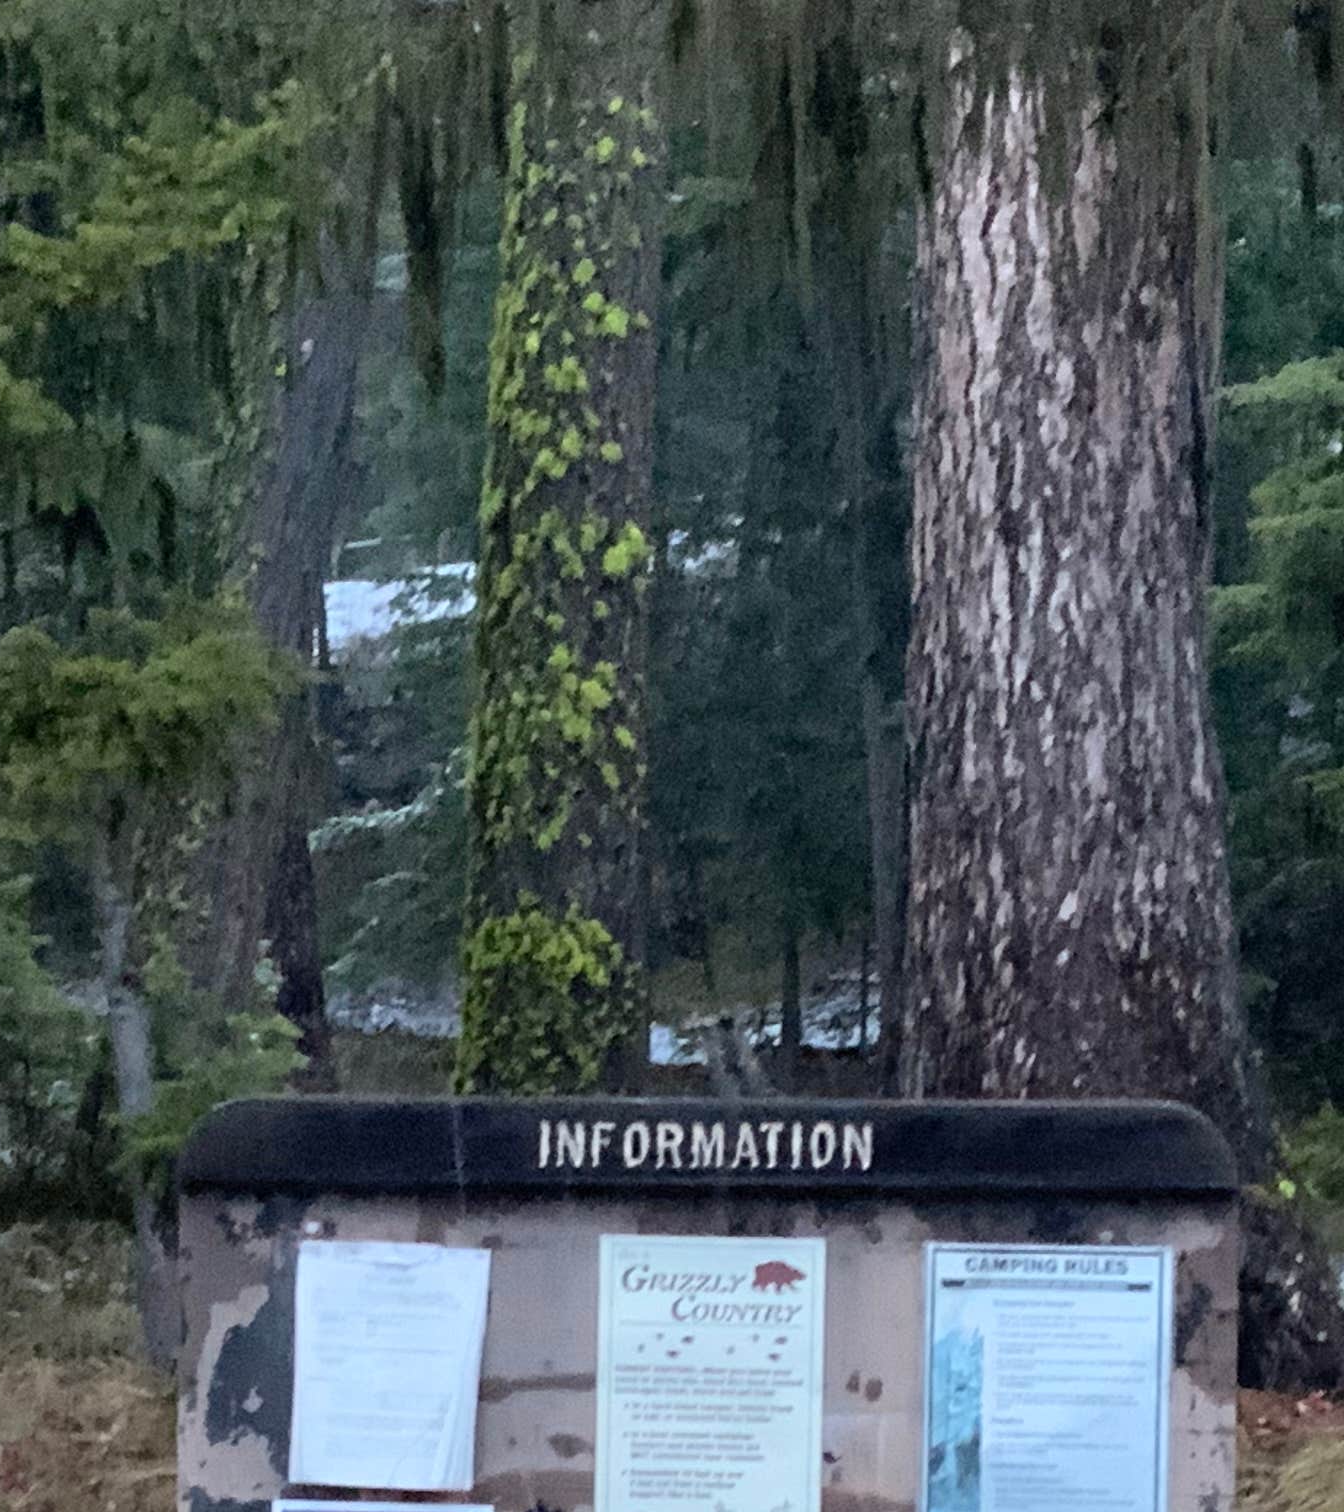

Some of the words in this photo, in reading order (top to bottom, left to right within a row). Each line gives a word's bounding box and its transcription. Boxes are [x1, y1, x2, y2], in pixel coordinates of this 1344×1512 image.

[538, 1119, 873, 1171] INFORMATION
[621, 1264, 747, 1294] GRIZZLY
[965, 1257, 1057, 1273] CAMPING
[1064, 1258, 1129, 1275] RULES
[671, 1295, 803, 1323] COUNTRY
